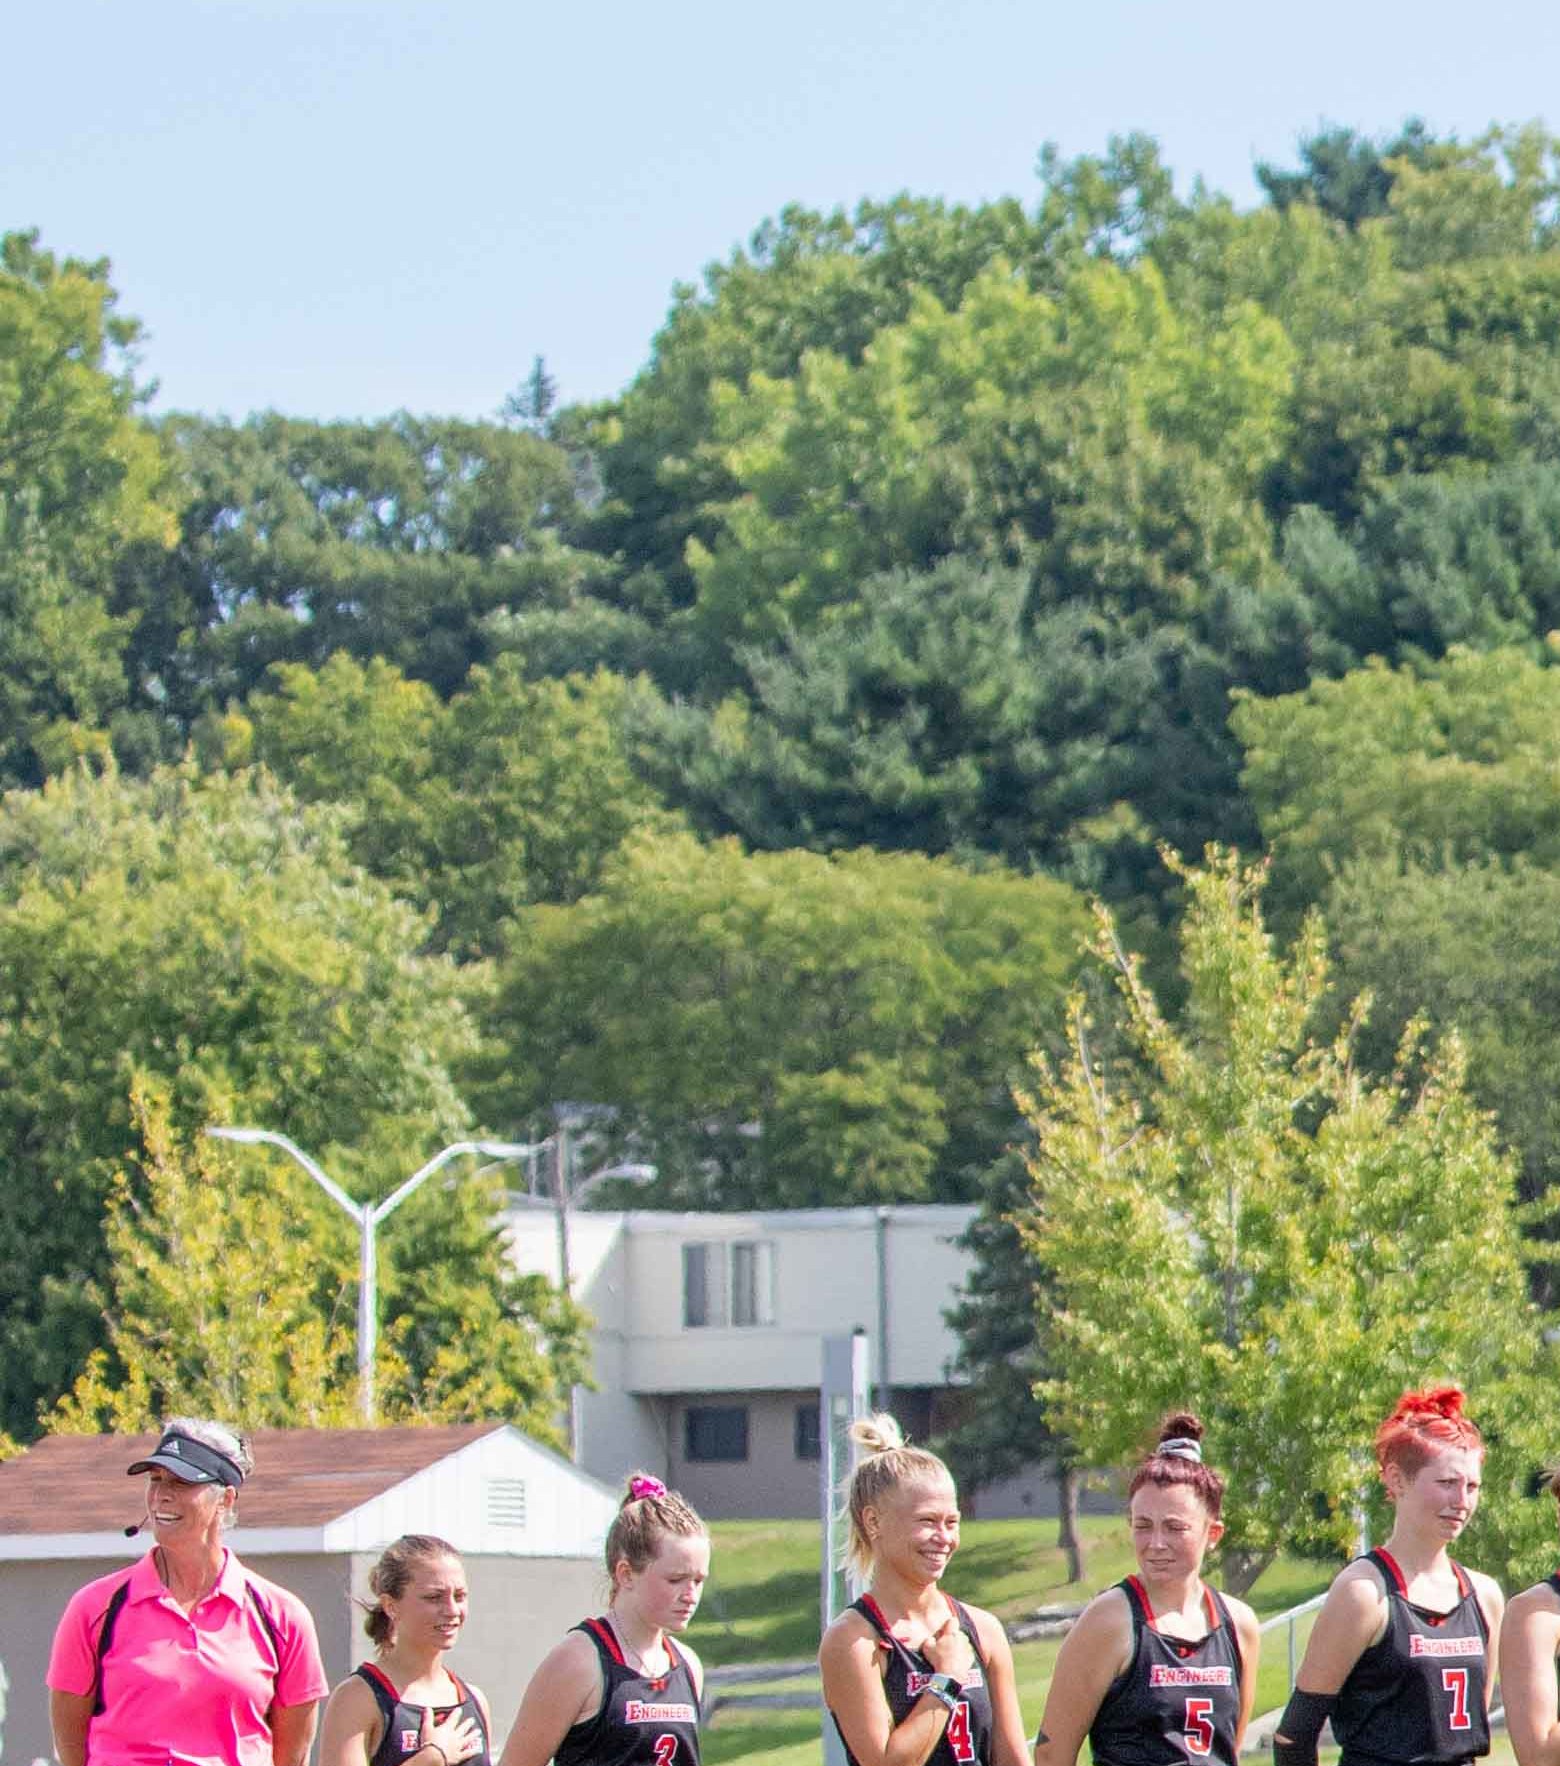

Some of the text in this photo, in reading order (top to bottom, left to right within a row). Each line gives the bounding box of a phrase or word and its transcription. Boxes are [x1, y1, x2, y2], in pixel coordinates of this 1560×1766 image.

[1184, 1698, 1214, 1756] 5
[1442, 1669, 1471, 1731] 7
[947, 1702, 975, 1762] 4
